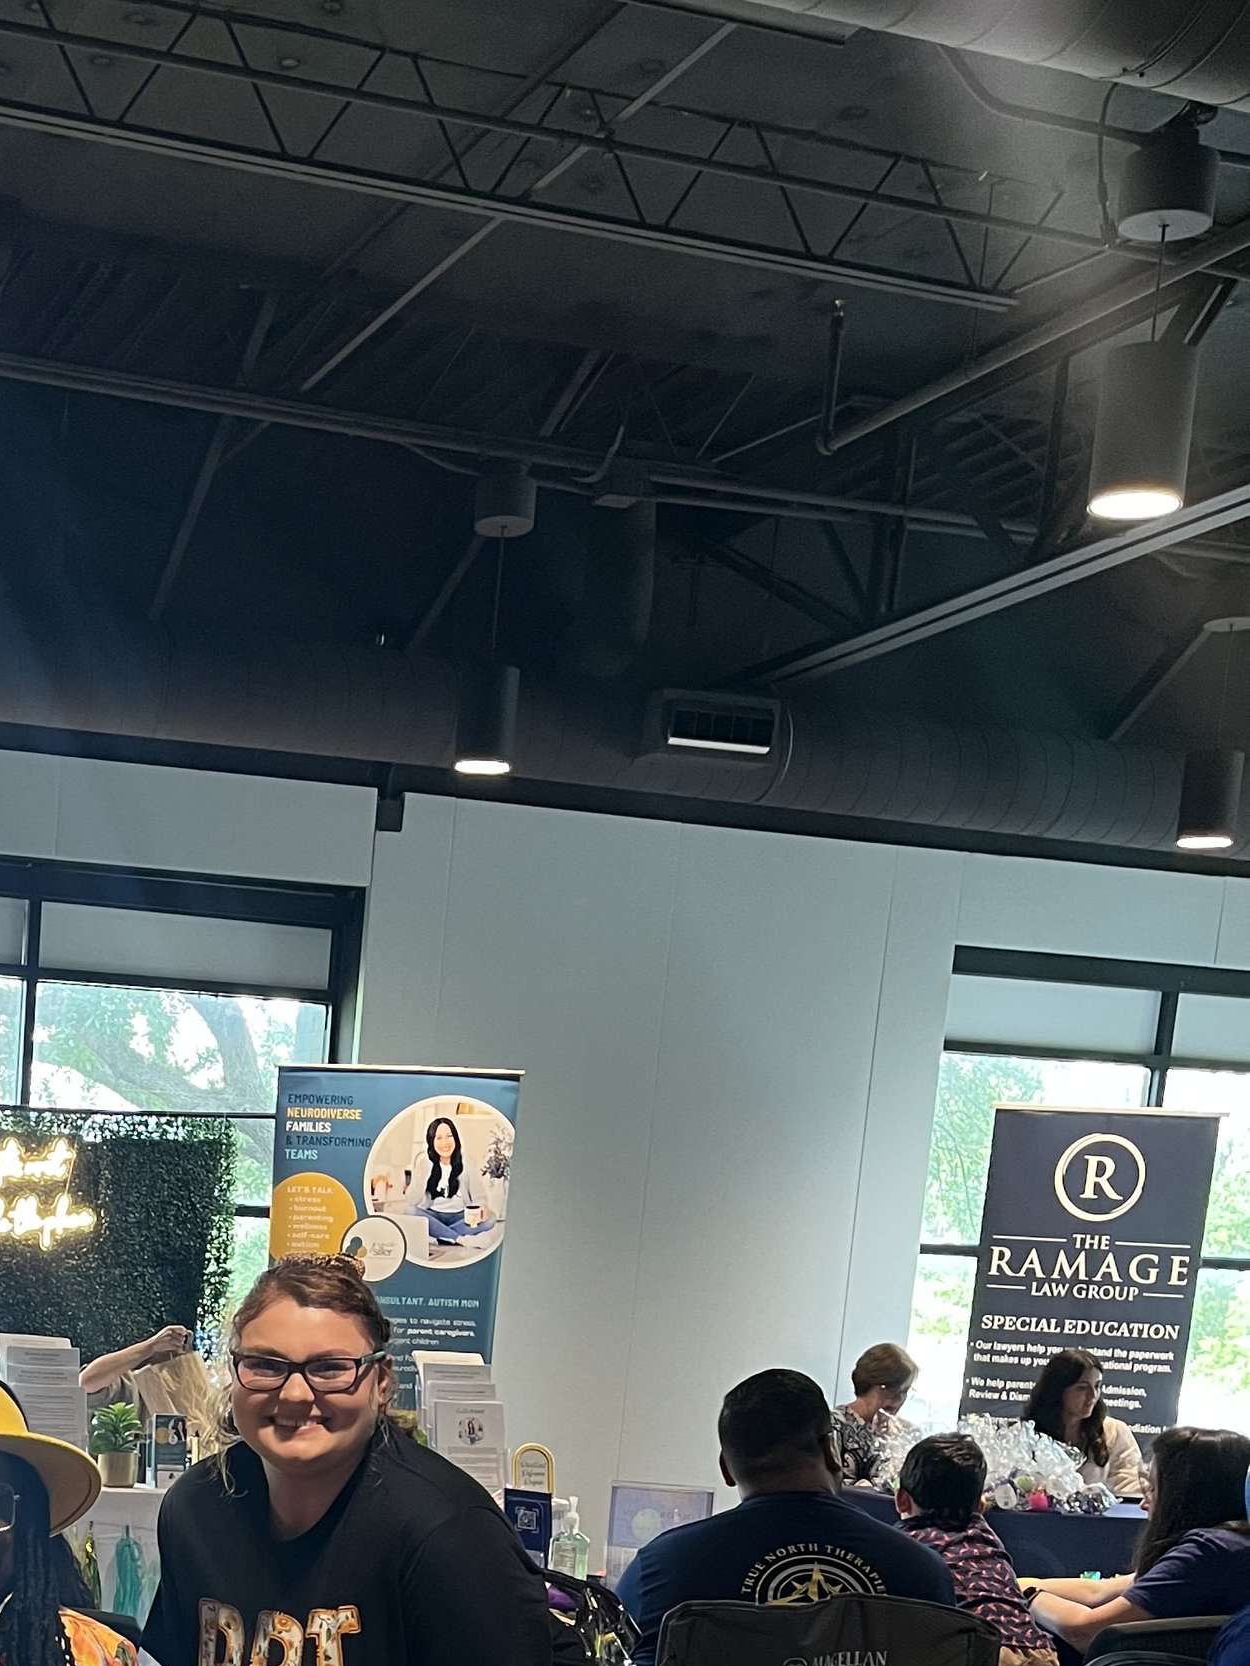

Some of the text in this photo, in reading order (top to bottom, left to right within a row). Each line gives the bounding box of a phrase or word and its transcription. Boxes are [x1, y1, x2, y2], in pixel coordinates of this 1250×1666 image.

[288, 1093, 354, 1105] EMPOWERING
[286, 1107, 363, 1120] NEURODIVERSE
[286, 1121, 332, 1133] FAMILIES
[286, 1136, 371, 1148] & TRANSFORMING
[284, 1148, 318, 1160] TEAMS
[1079, 1154, 1124, 1200] R
[293, 1204, 327, 1213] burnout
[292, 1214, 334, 1223] parenting
[291, 1232, 330, 1240] self-care
[1072, 1234, 1111, 1250] THE
[988, 1245, 1190, 1286] RAMAGE
[1030, 1281, 1140, 1302] LAW GROUP
[428, 1298, 459, 1307] AUTISM
[461, 1300, 480, 1308] MOM
[419, 1318, 451, 1327] navigate
[981, 1314, 1181, 1340] SPECIAL EDUCATION
[406, 1327, 433, 1335] parent
[411, 1337, 440, 1345] children
[975, 1339, 993, 1351] Our
[993, 1341, 1025, 1354] lawyers
[1026, 1342, 1046, 1356] help
[1113, 1347, 1128, 1358] the
[1128, 1348, 1175, 1361] paperwork
[973, 1352, 991, 1363] that
[991, 1354, 1019, 1364] makes
[1020, 1357, 1031, 1367] up
[971, 1376, 985, 1387] We
[986, 1377, 1005, 1389] help
[969, 1388, 1000, 1401] Review
[1000, 1390, 1007, 1401] &
[741, 1561, 765, 1594] TRUE
[766, 1543, 818, 1563] NORTH
